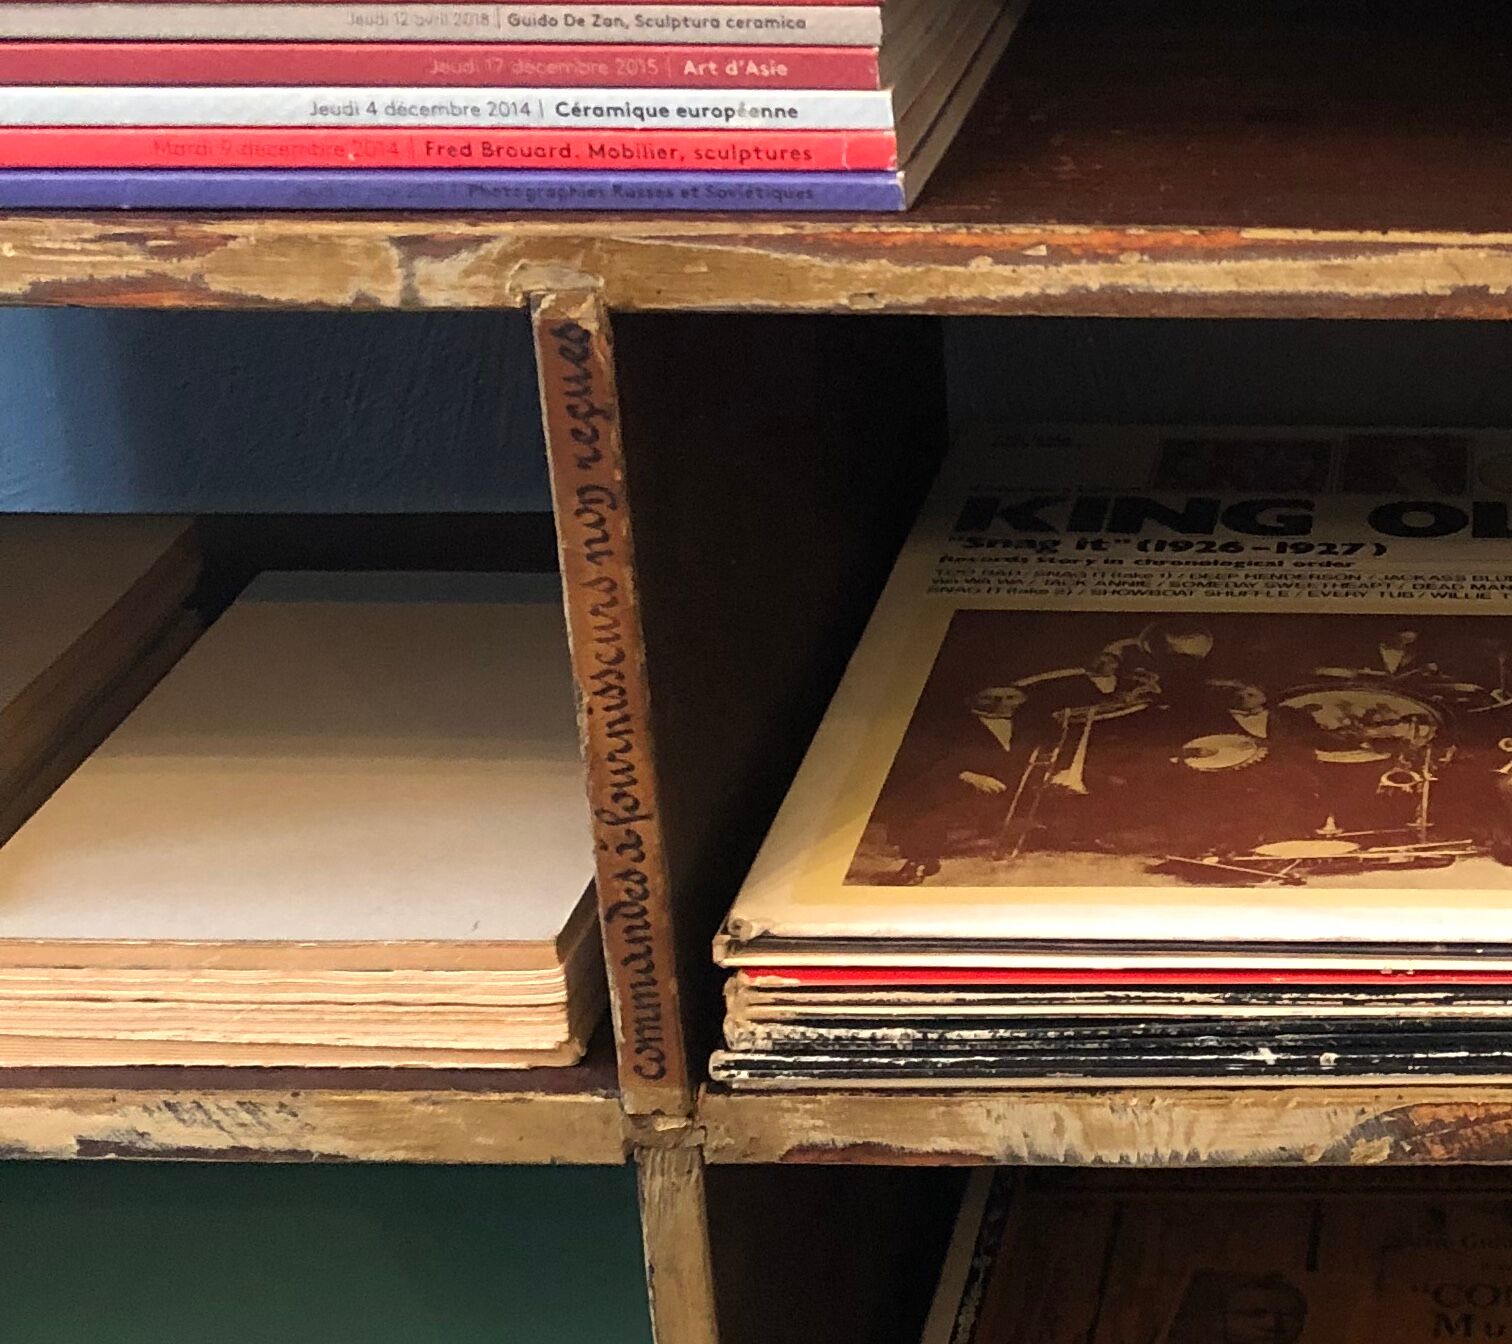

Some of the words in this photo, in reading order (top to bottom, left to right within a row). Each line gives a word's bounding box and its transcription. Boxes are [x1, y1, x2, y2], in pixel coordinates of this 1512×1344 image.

[347, 12, 389, 28] Jeudi
[394, 12, 409, 27] 12
[413, 12, 448, 27] avril
[453, 12, 489, 28] 2018
[506, 13, 558, 30] Guido
[563, 13, 586, 30] De
[591, 14, 630, 32] Zan,
[634, 13, 720, 34] Sculptura
[725, 15, 807, 31] ceramica
[430, 58, 480, 76] Jeudi
[484, 59, 503, 75] 17
[615, 58, 659, 76] 2015
[683, 59, 719, 77] Art
[725, 59, 788, 77] d'Asie
[308, 100, 360, 118] Jeudi
[365, 101, 377, 117] 4
[486, 100, 530, 118] 2014
[554, 99, 669, 122] Céramique
[675, 101, 799, 122] européenne
[425, 140, 473, 158] Fred
[588, 142, 686, 162] Mobilier,
[693, 143, 813, 165] sculptures
[680, 184, 699, 201] et
[549, 320, 614, 470] reçues
[574, 484, 616, 566] non
[952, 494, 1316, 536] KING
[578, 574, 653, 826] fournisseurs
[604, 868, 668, 1080] commandes
